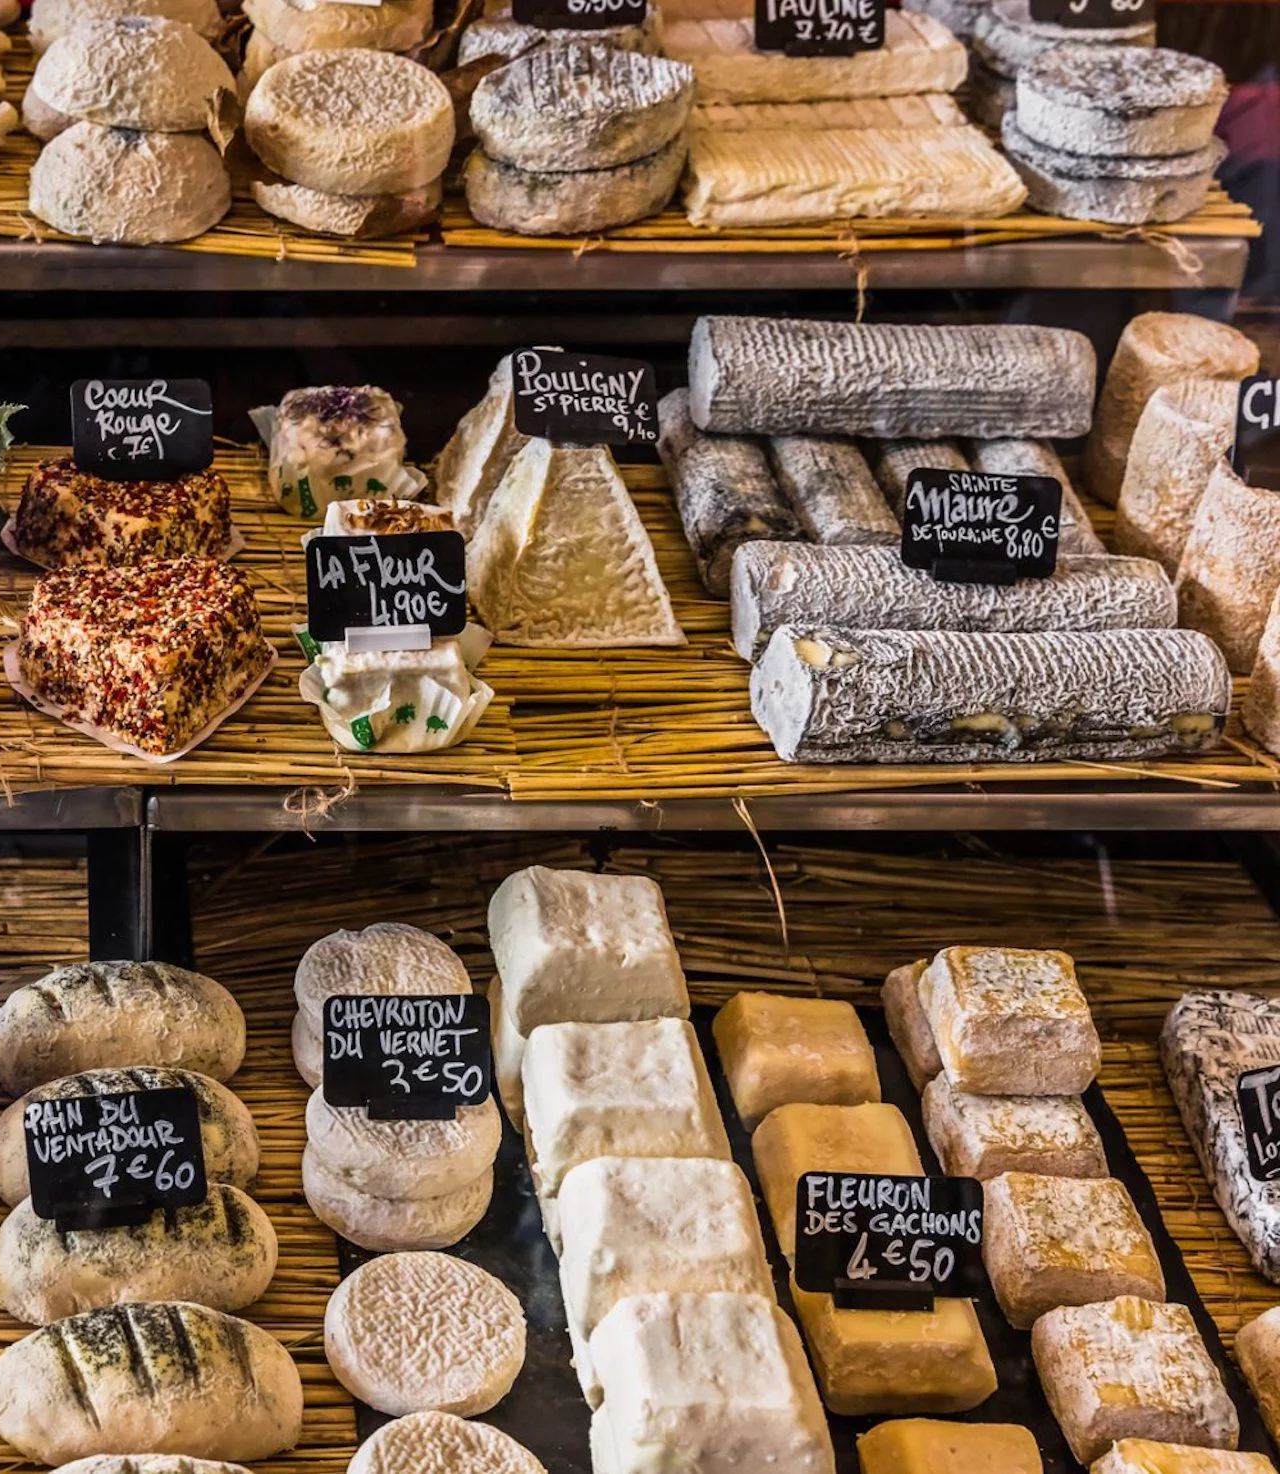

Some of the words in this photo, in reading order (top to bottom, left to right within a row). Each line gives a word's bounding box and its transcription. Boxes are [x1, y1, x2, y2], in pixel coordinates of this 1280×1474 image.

[911, 523, 933, 541] DE
[369, 581, 448, 626] 4,90€
[330, 994, 466, 1029] CHEVROTON
[327, 1029, 363, 1059] DU
[379, 1027, 479, 1058] VERNET
[98, 1095, 140, 1126] DU
[33, 1120, 184, 1164] VENTADOUR
[805, 1175, 931, 1213] FLEURON
[804, 1210, 858, 1235] DES
[869, 1209, 981, 1244] GACHONS
